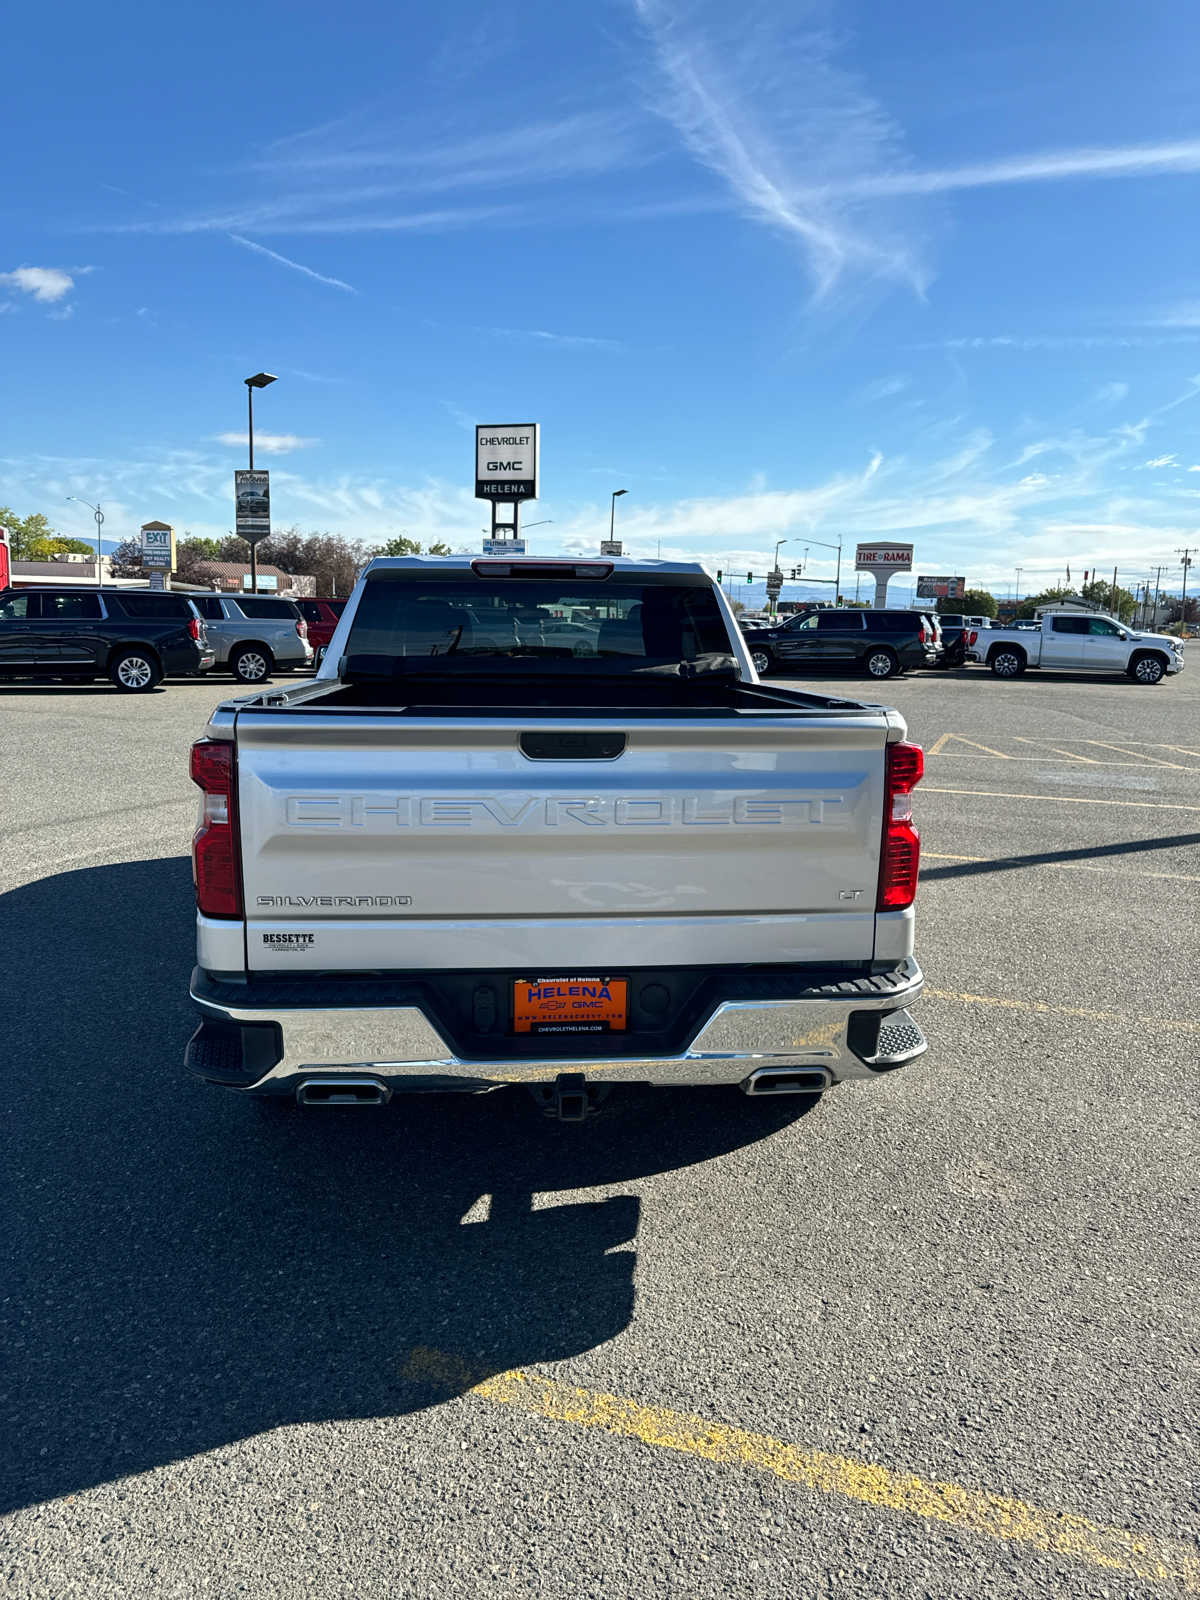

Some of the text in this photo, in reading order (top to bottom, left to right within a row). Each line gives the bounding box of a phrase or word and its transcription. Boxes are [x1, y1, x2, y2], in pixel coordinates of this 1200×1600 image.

[480, 436, 530, 446] CHEVROLET
[486, 461, 523, 471] GMC
[483, 484, 526, 493] HELENA
[146, 532, 168, 544] EXIT
[858, 552, 911, 562] TIRE RAMA
[286, 797, 842, 825] CHEVROLET
[839, 889, 864, 900] LT
[256, 895, 413, 907] SILVERADO
[263, 933, 315, 943] BESSETTE
[527, 986, 612, 1003] HELENA
[538, 1025, 602, 1033] CHEVROLETHELENA.COM
